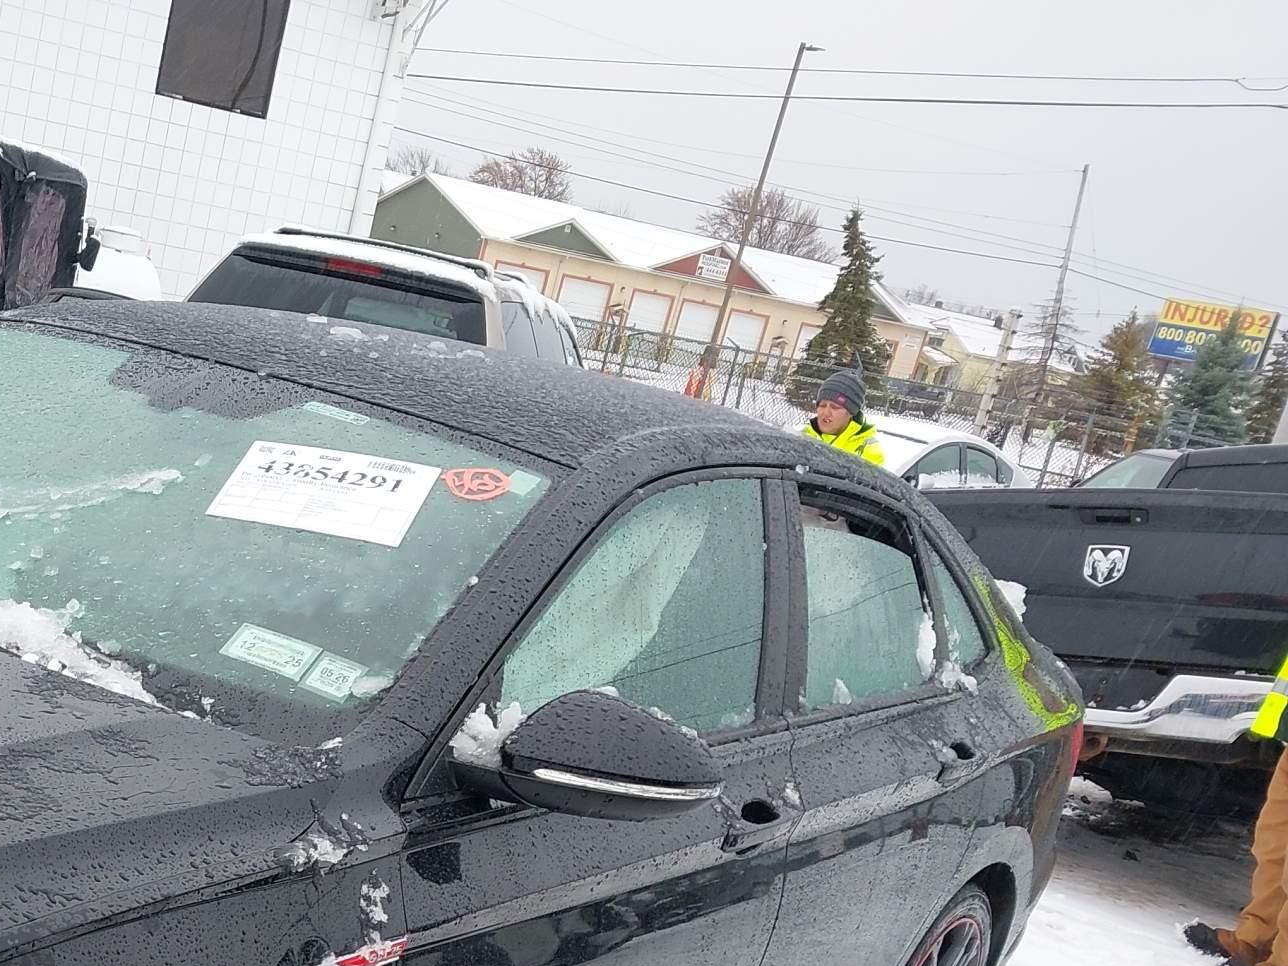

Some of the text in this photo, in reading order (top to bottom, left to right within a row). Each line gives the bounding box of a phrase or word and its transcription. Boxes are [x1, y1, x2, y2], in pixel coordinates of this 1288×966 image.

[1164, 301, 1271, 334] INJURD?
[258, 459, 404, 494] 43854291
[284, 655, 304, 668] 25
